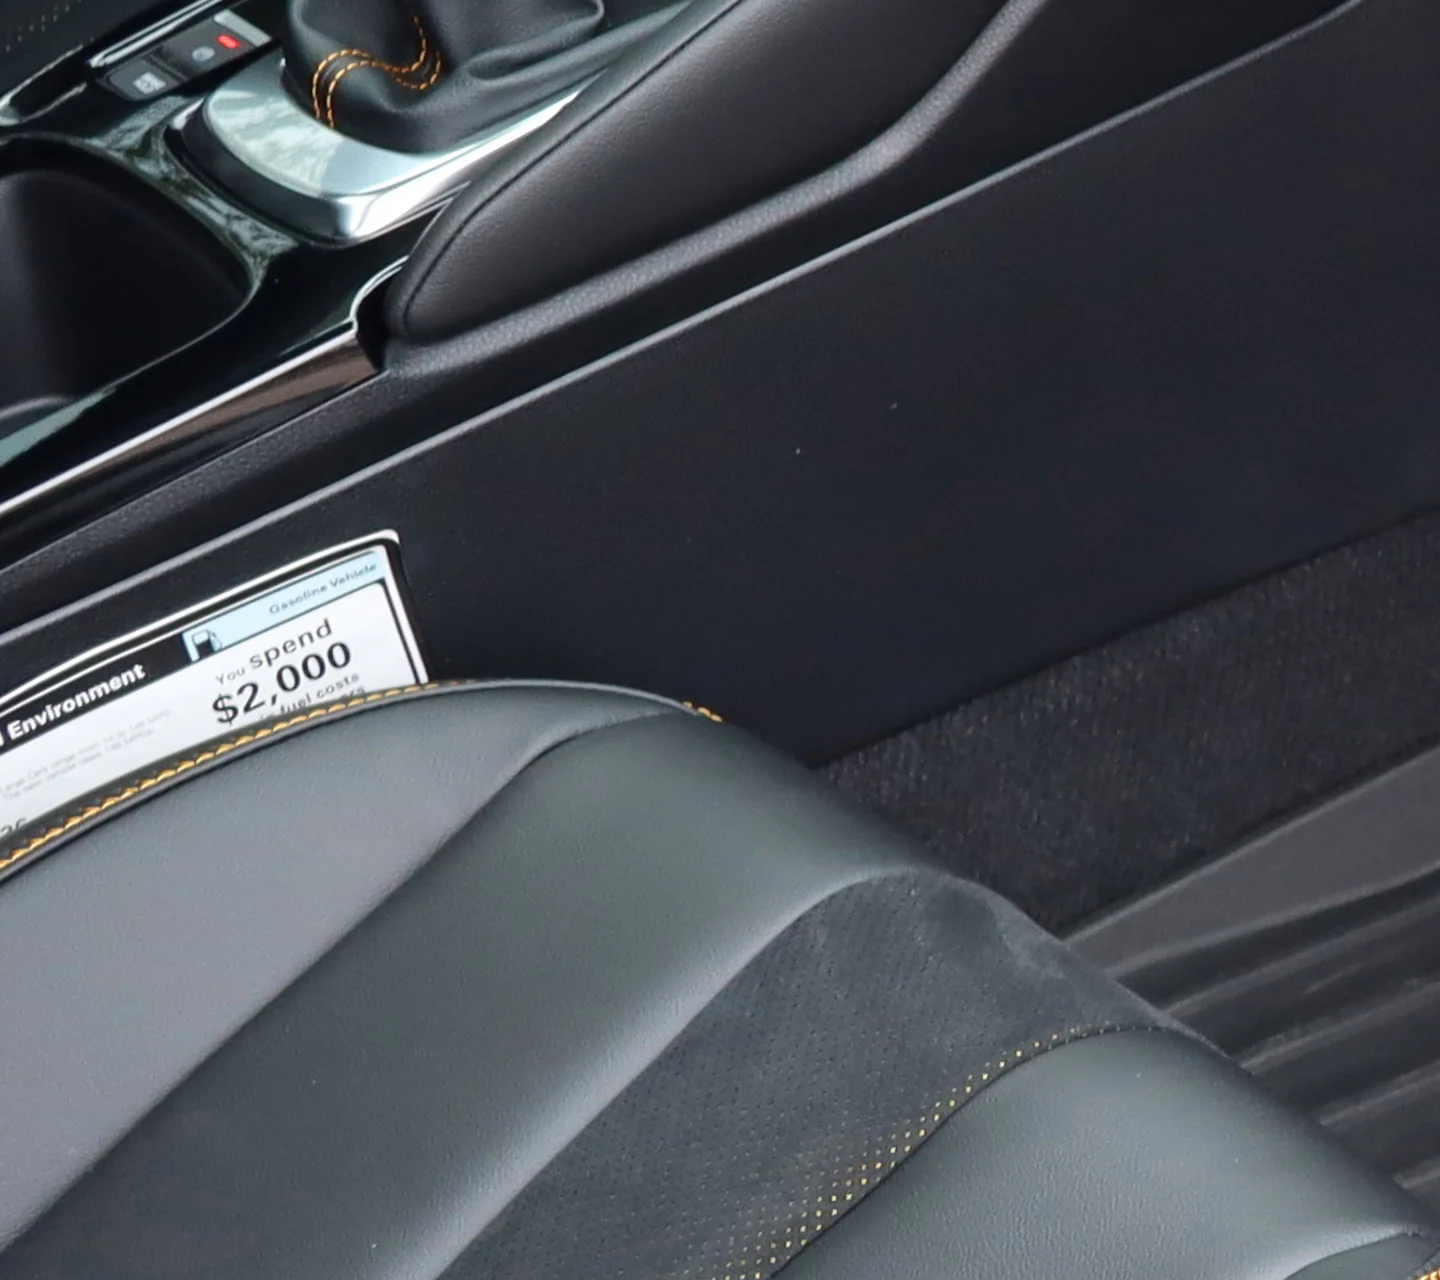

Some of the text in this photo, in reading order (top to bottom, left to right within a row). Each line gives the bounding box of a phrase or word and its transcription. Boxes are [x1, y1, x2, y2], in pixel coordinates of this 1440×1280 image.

[269, 563, 377, 614] Gasoline Vehicle
[212, 642, 351, 726] $2,000
[216, 618, 332, 685] You spend
[7, 664, 146, 741] Environment
[316, 673, 360, 698] costs
